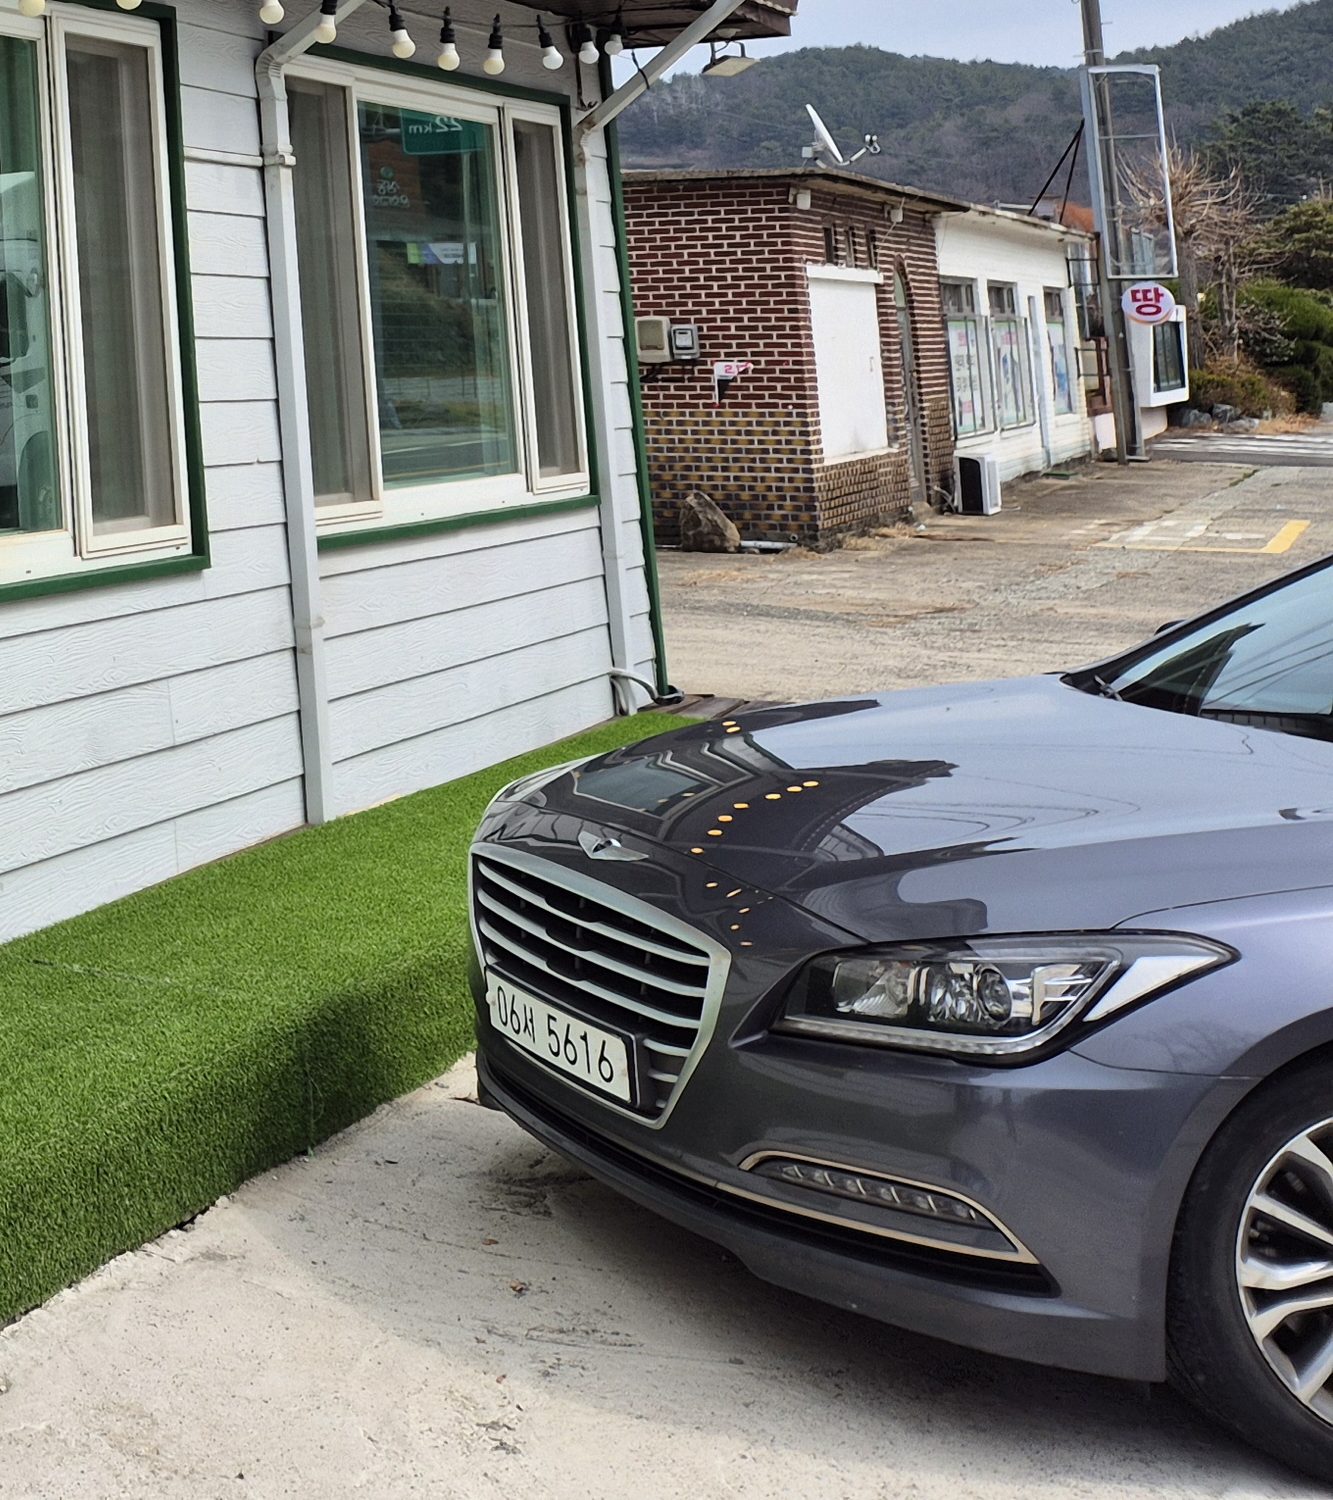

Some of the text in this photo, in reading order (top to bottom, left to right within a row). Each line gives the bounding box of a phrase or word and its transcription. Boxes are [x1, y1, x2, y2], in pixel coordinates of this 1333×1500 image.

[1130, 287, 1165, 316] 땅
[496, 985, 615, 1084] 06서 5616
